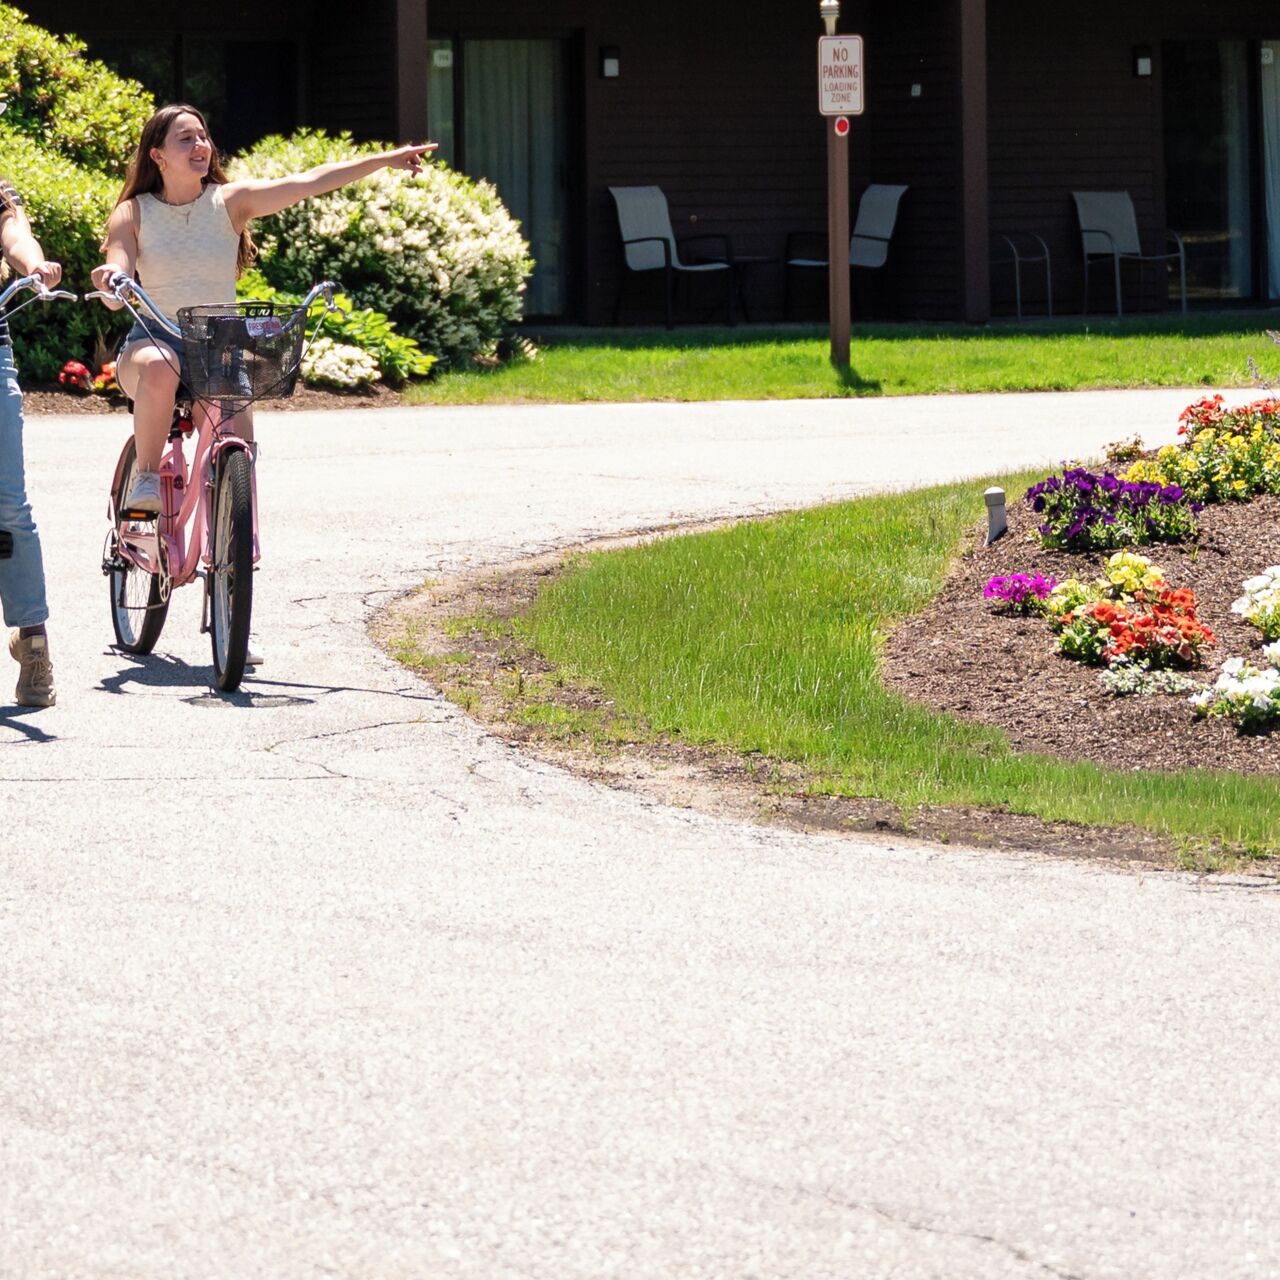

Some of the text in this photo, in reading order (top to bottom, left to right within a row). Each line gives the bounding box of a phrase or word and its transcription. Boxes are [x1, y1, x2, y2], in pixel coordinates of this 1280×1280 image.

[832, 47, 848, 62] NO
[823, 65, 859, 79] PARKING
[824, 82, 858, 92] LOADING
[831, 92, 851, 103] ZONE
